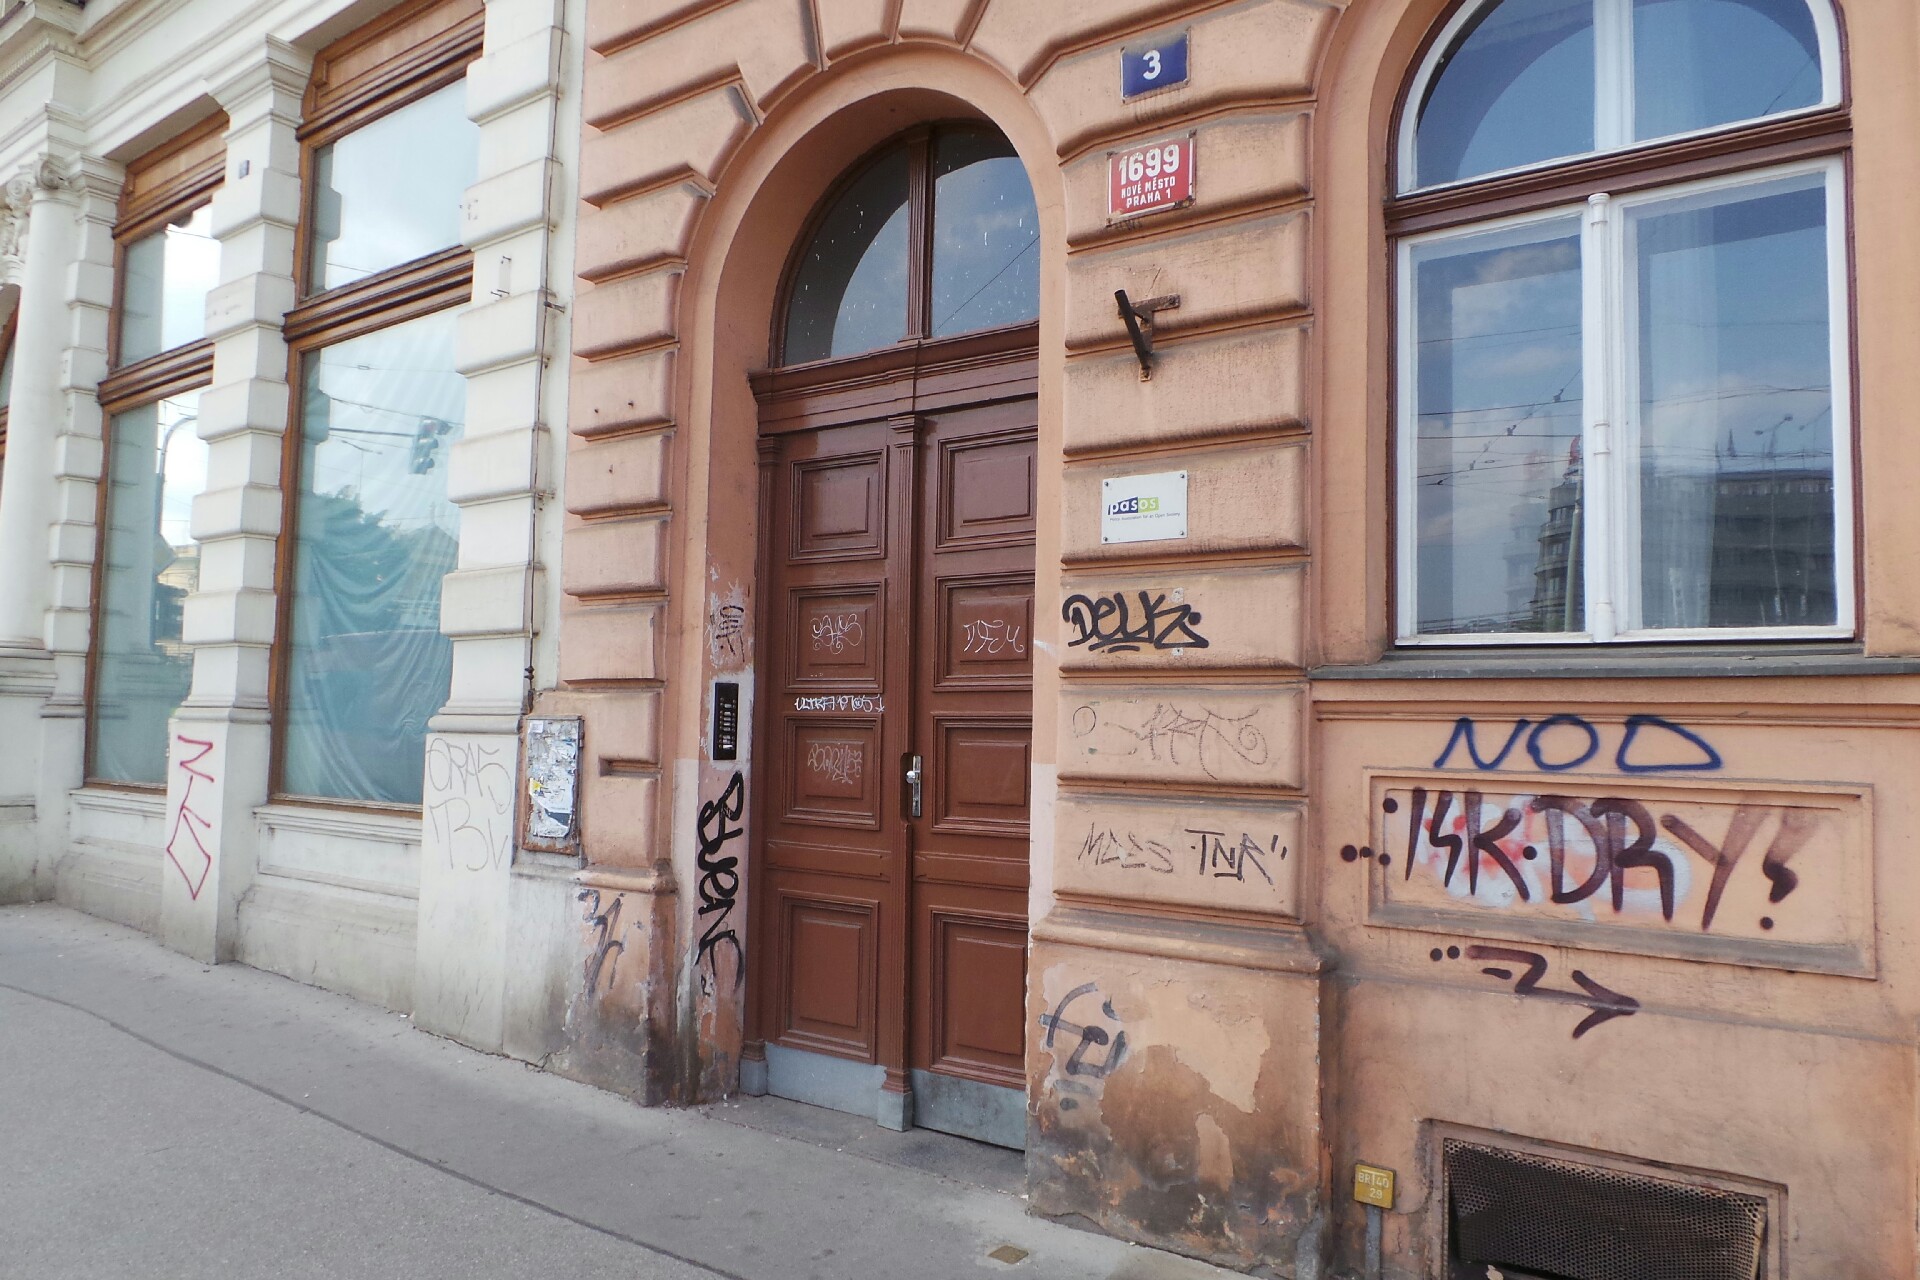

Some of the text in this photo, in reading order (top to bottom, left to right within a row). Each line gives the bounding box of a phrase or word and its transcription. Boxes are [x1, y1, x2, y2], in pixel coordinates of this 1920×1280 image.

[1142, 50, 1161, 80] 3
[1118, 144, 1180, 185] 1699
[1121, 176, 1176, 199] NOVÉ MĚSTO
[1126, 187, 1171, 208] PRAHA 1
[1109, 498, 1156, 515] pasos
[1369, 1188, 1383, 1199] 29
